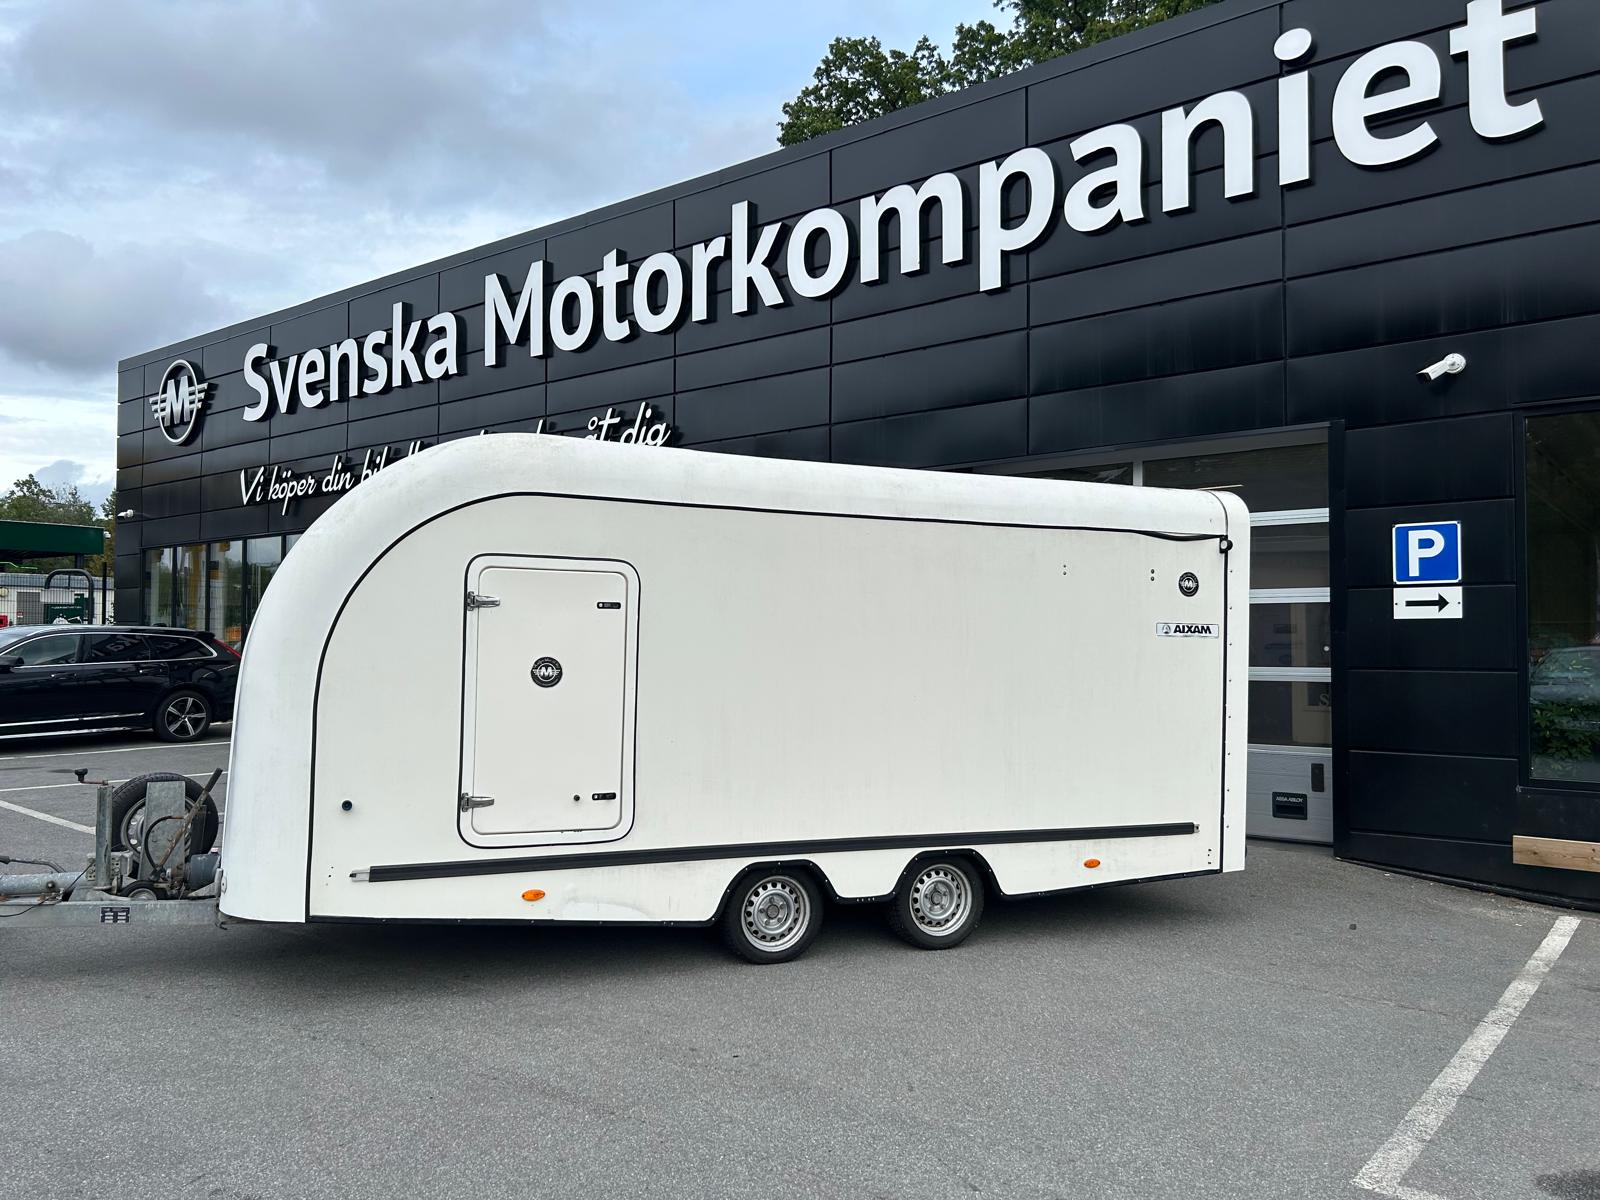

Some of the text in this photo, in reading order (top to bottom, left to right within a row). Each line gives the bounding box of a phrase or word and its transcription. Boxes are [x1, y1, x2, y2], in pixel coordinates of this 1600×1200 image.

[242, 0, 1544, 422] Svenska Motorkompaniet
[240, 466, 264, 505] Vi
[268, 465, 317, 516] köper
[321, 455, 354, 493] din
[619, 401, 671, 447] dig
[1408, 529, 1445, 577] P
[1173, 624, 1212, 635] AIXAM
